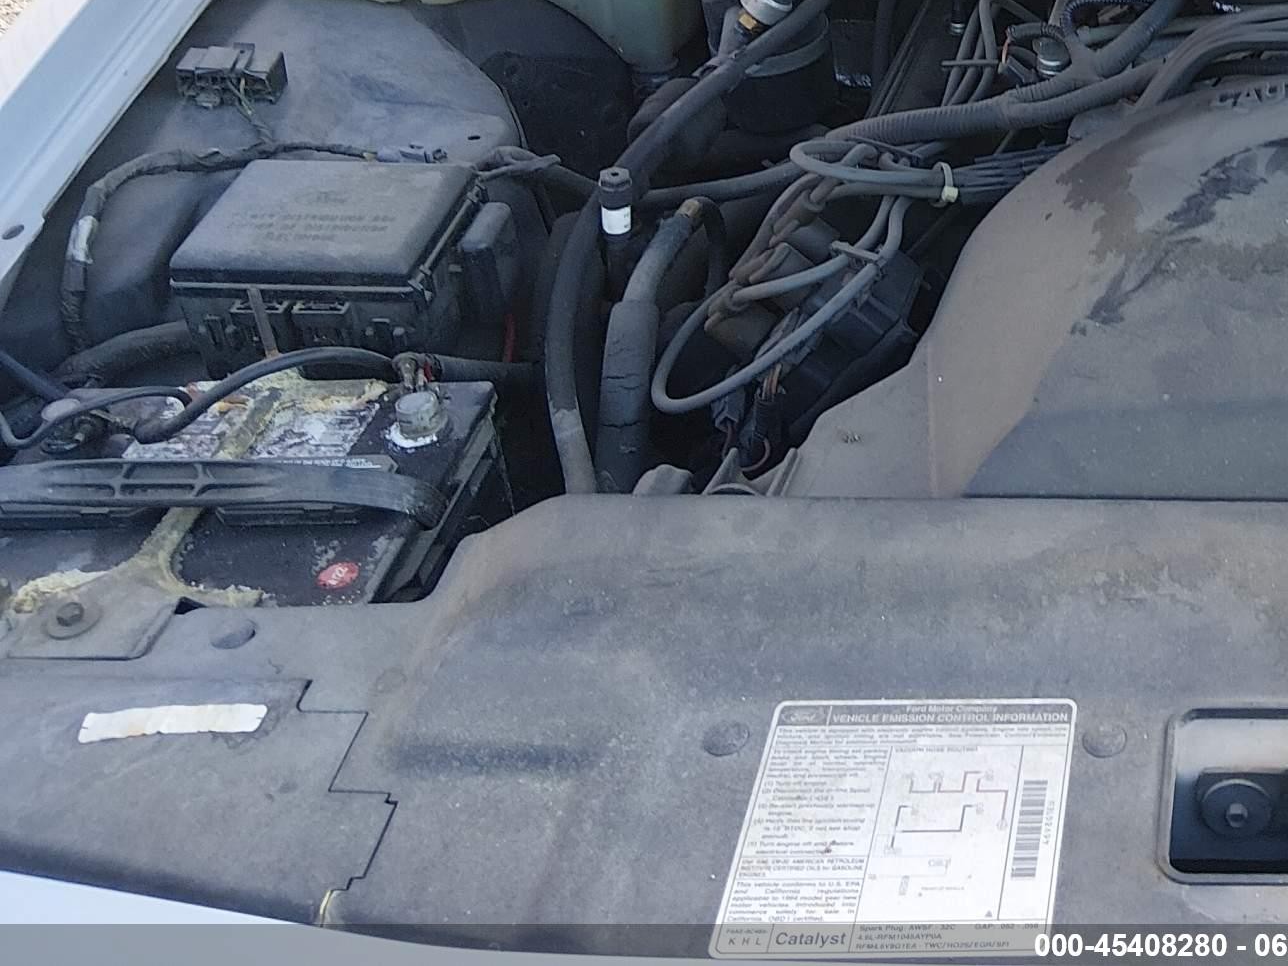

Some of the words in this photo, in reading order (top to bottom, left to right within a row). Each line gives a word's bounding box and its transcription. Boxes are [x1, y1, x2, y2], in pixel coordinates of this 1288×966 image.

[906, 705, 927, 715] Ford
[929, 705, 953, 715] Motor
[956, 705, 998, 715] Company
[833, 713, 881, 724] VEHICLE
[883, 713, 935, 724] EMISSION
[938, 713, 990, 724] CONTROL
[993, 713, 1068, 724] INFORMATION
[728, 938, 736, 946] K
[776, 932, 847, 948] Catalyst
